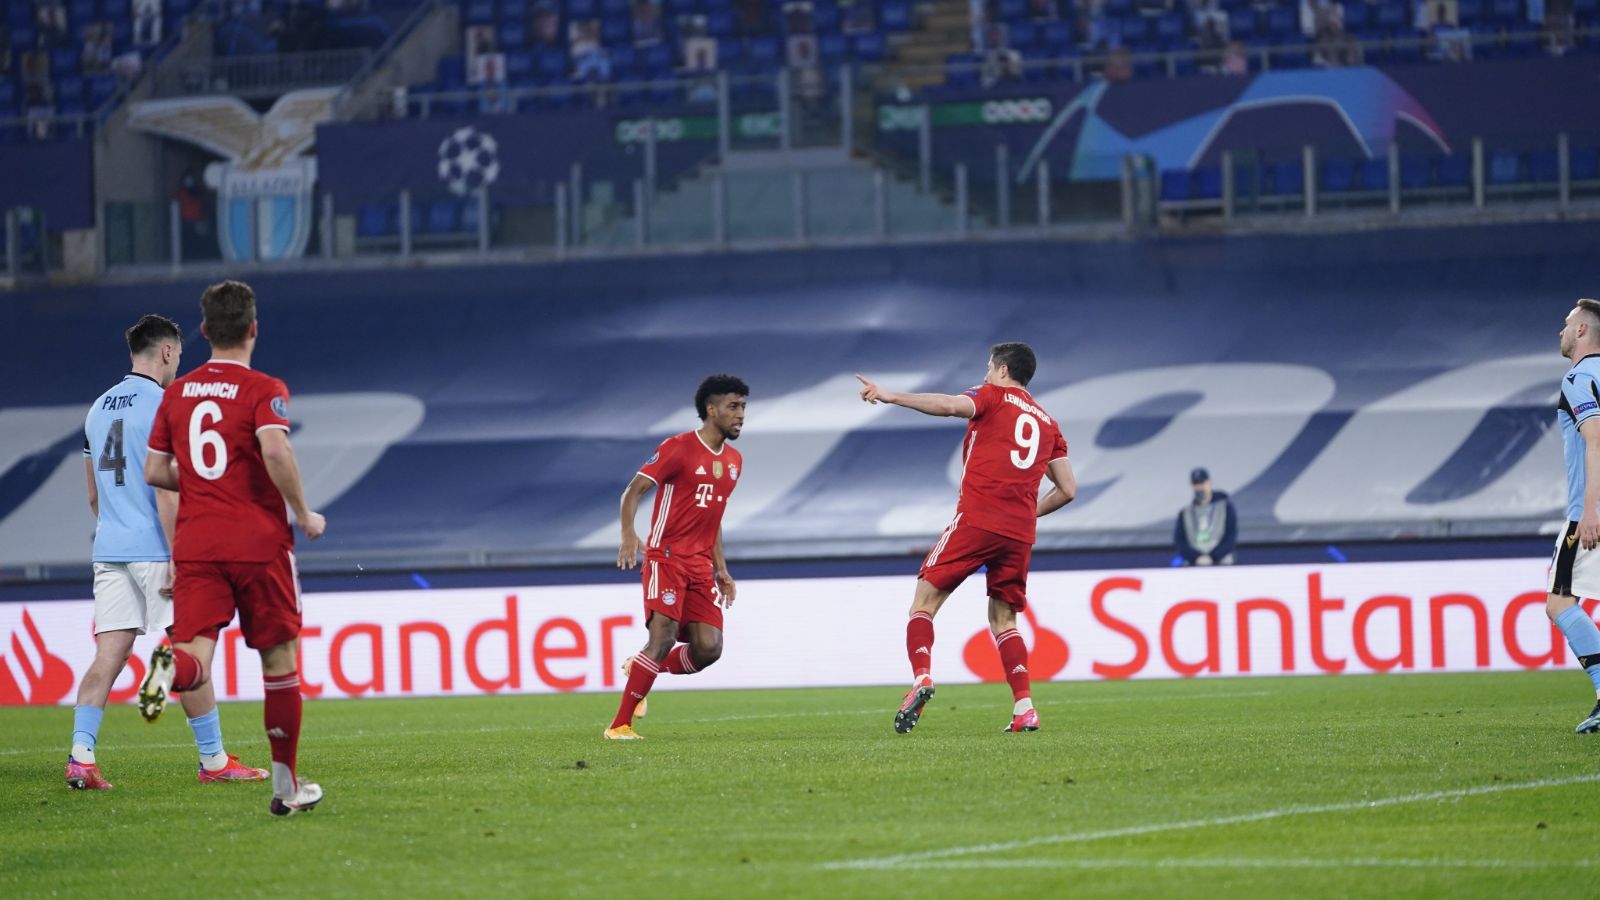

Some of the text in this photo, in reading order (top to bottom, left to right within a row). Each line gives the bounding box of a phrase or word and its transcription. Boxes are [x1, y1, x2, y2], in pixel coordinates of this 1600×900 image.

[102, 393, 138, 411] PATRIC
[182, 381, 239, 399] KIMMICH
[1004, 392, 1051, 426] LEWANDOWSKI
[98, 418, 126, 487] 4
[188, 400, 228, 480] 6
[1010, 413, 1040, 469] 9
